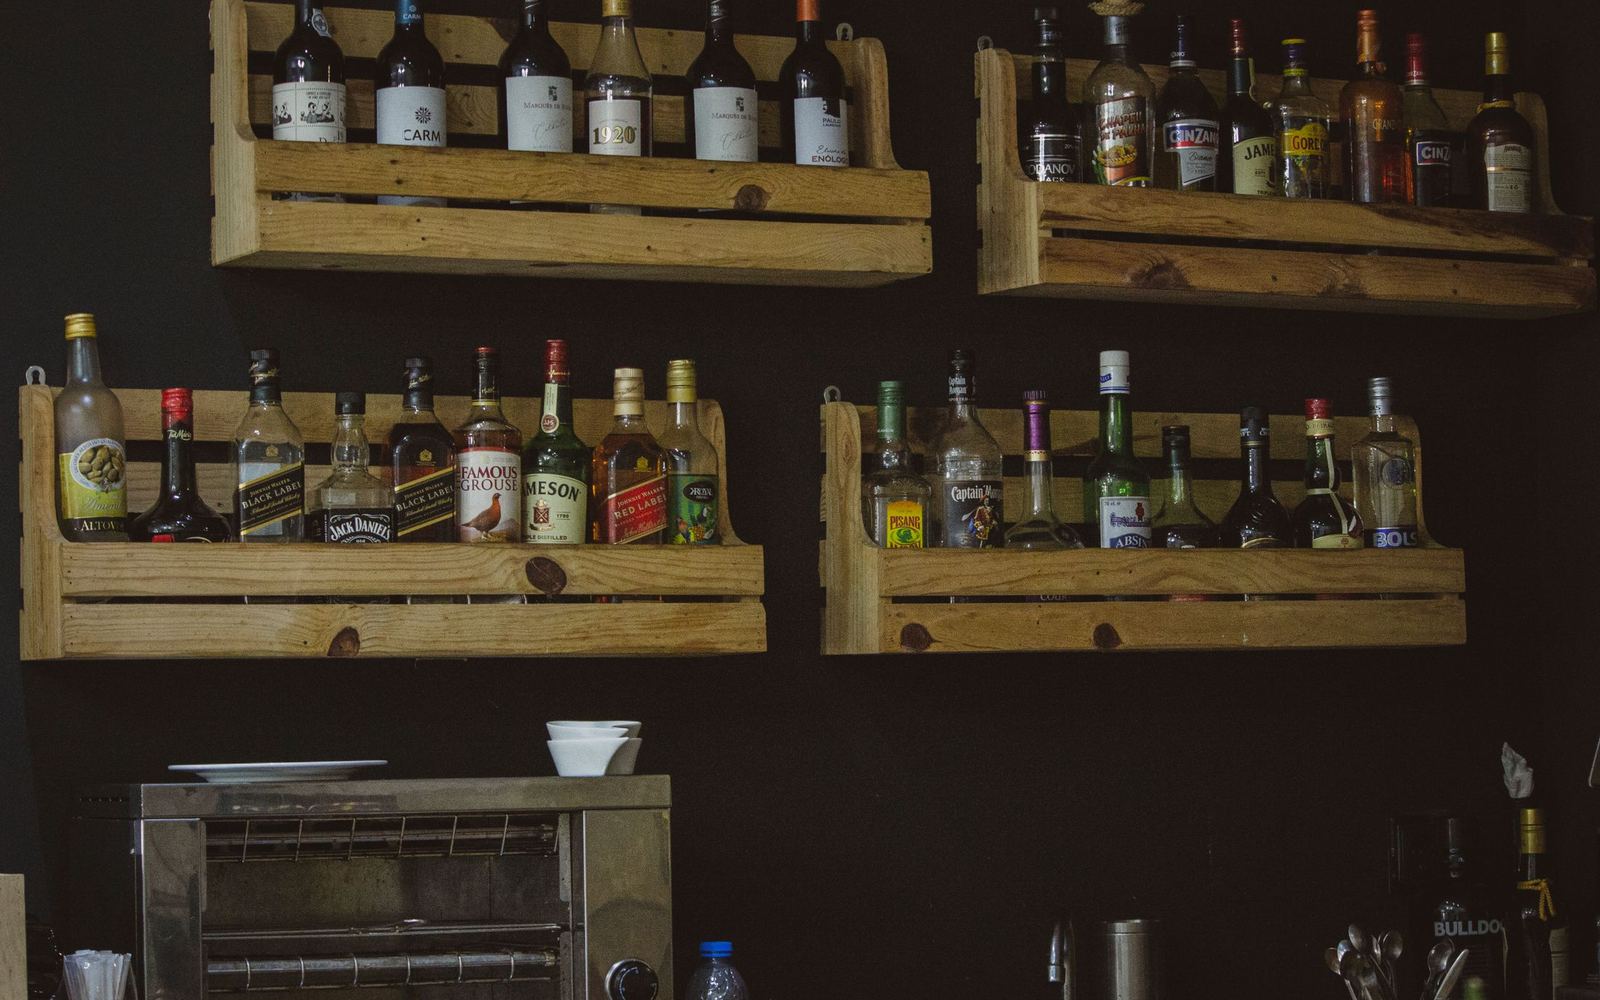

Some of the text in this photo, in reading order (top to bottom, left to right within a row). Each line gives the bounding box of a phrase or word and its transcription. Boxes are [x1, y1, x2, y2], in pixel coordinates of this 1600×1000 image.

[403, 129, 441, 142] CARM
[593, 126, 636, 144] 1920
[461, 466, 518, 480] FAMOUS
[460, 478, 518, 492] GROUSE
[951, 484, 983, 502] Captain
[242, 481, 303, 510] BLACK LABEL
[396, 484, 454, 512] BLACK LABEL
[614, 506, 635, 520] RED
[637, 493, 667, 511] LABEL
[329, 521, 355, 541] JACK
[890, 515, 921, 530] PISANG
[1373, 531, 1417, 548] BOLS
